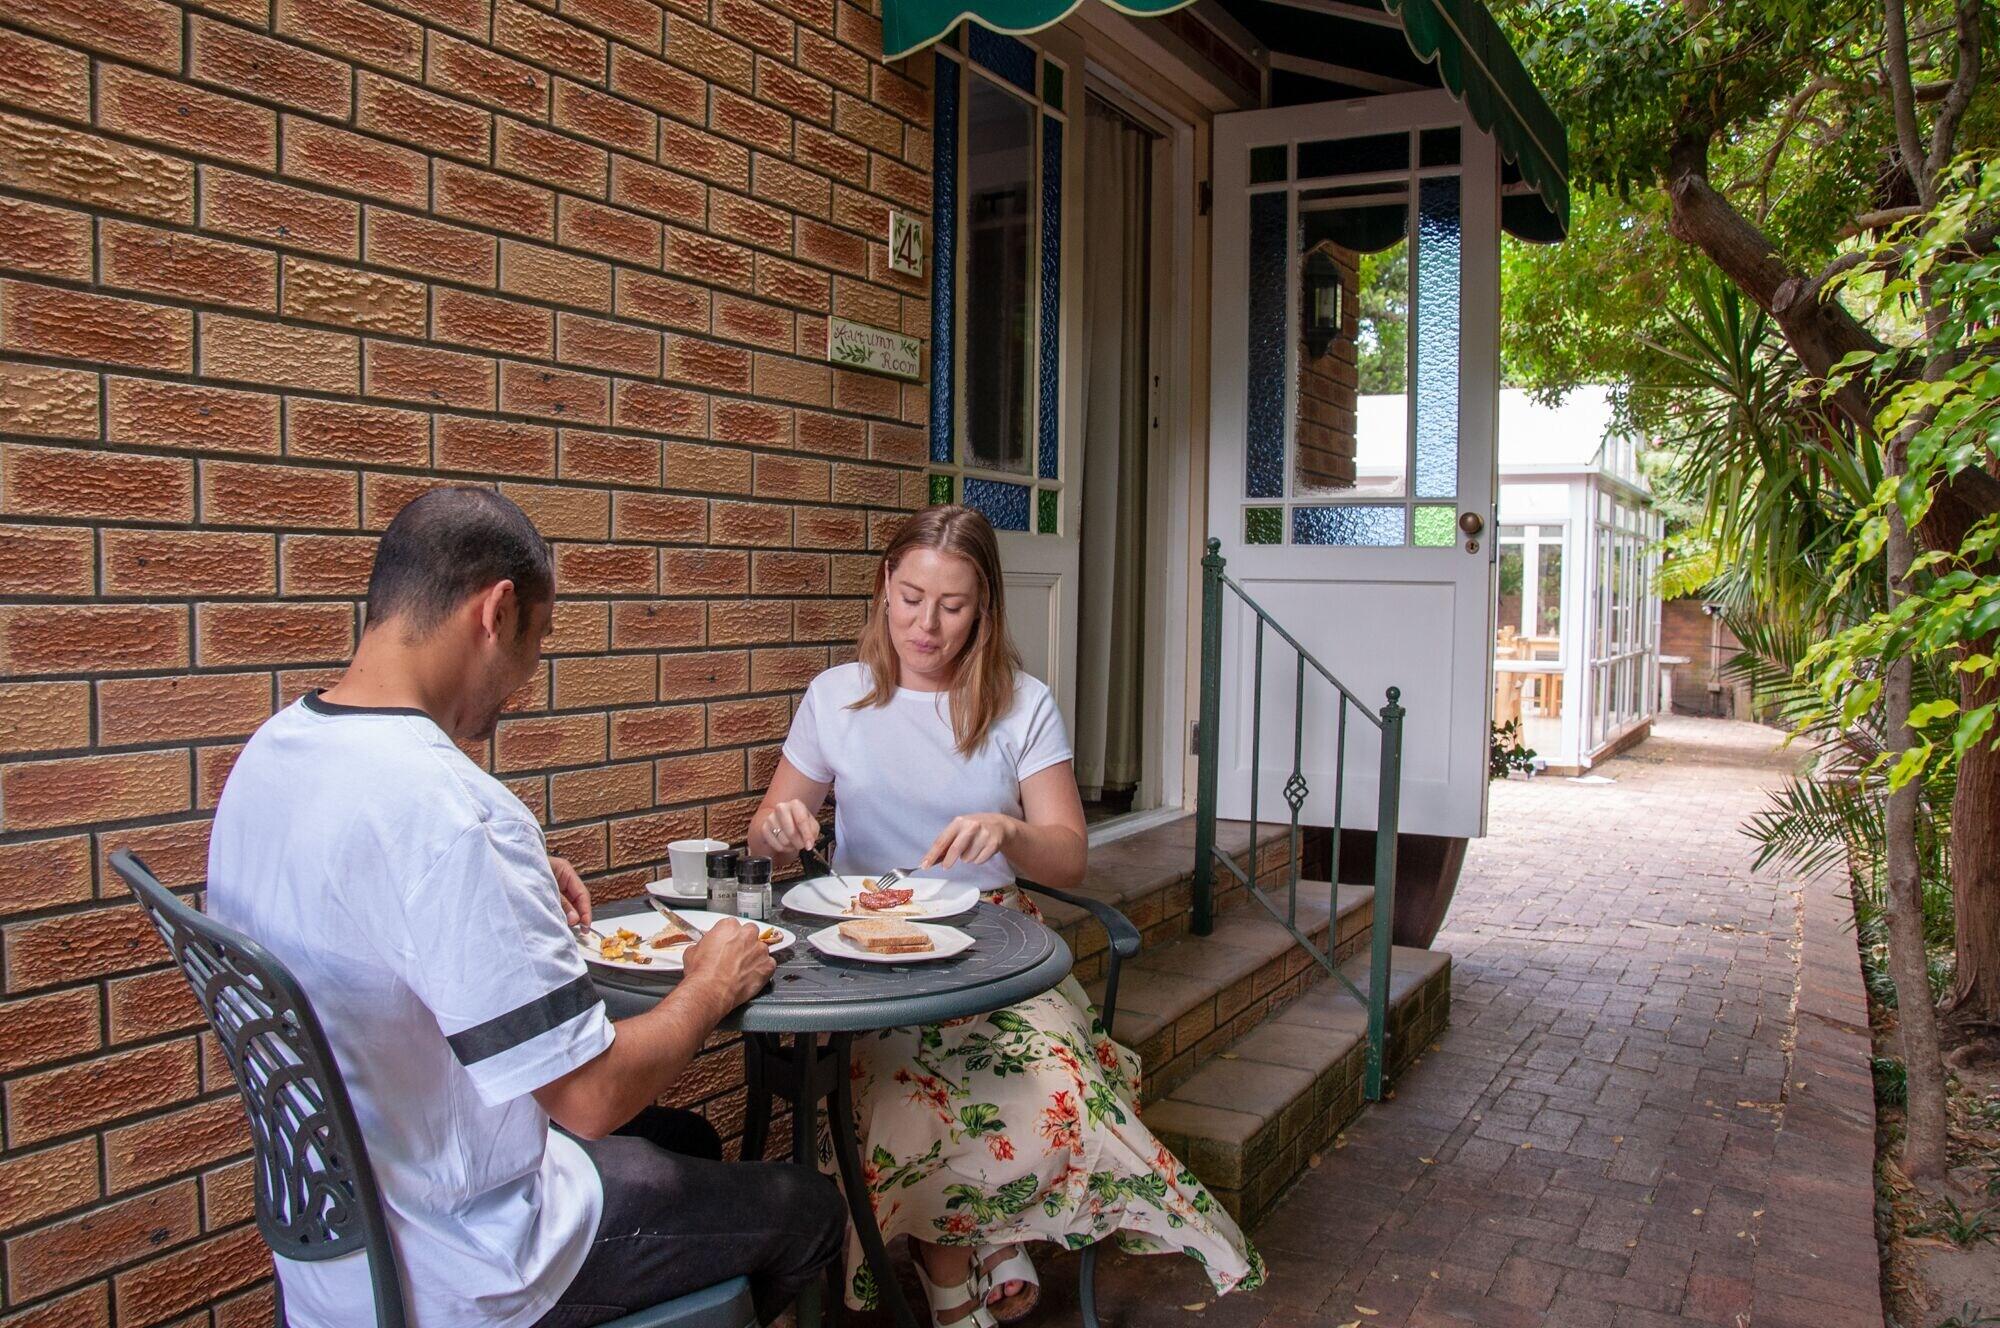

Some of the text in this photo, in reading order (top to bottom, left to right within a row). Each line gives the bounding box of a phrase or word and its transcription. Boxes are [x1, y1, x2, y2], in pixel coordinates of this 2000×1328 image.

[897, 223, 917, 269] 4
[834, 324, 895, 351] Autumn
[880, 351, 917, 374] Room
